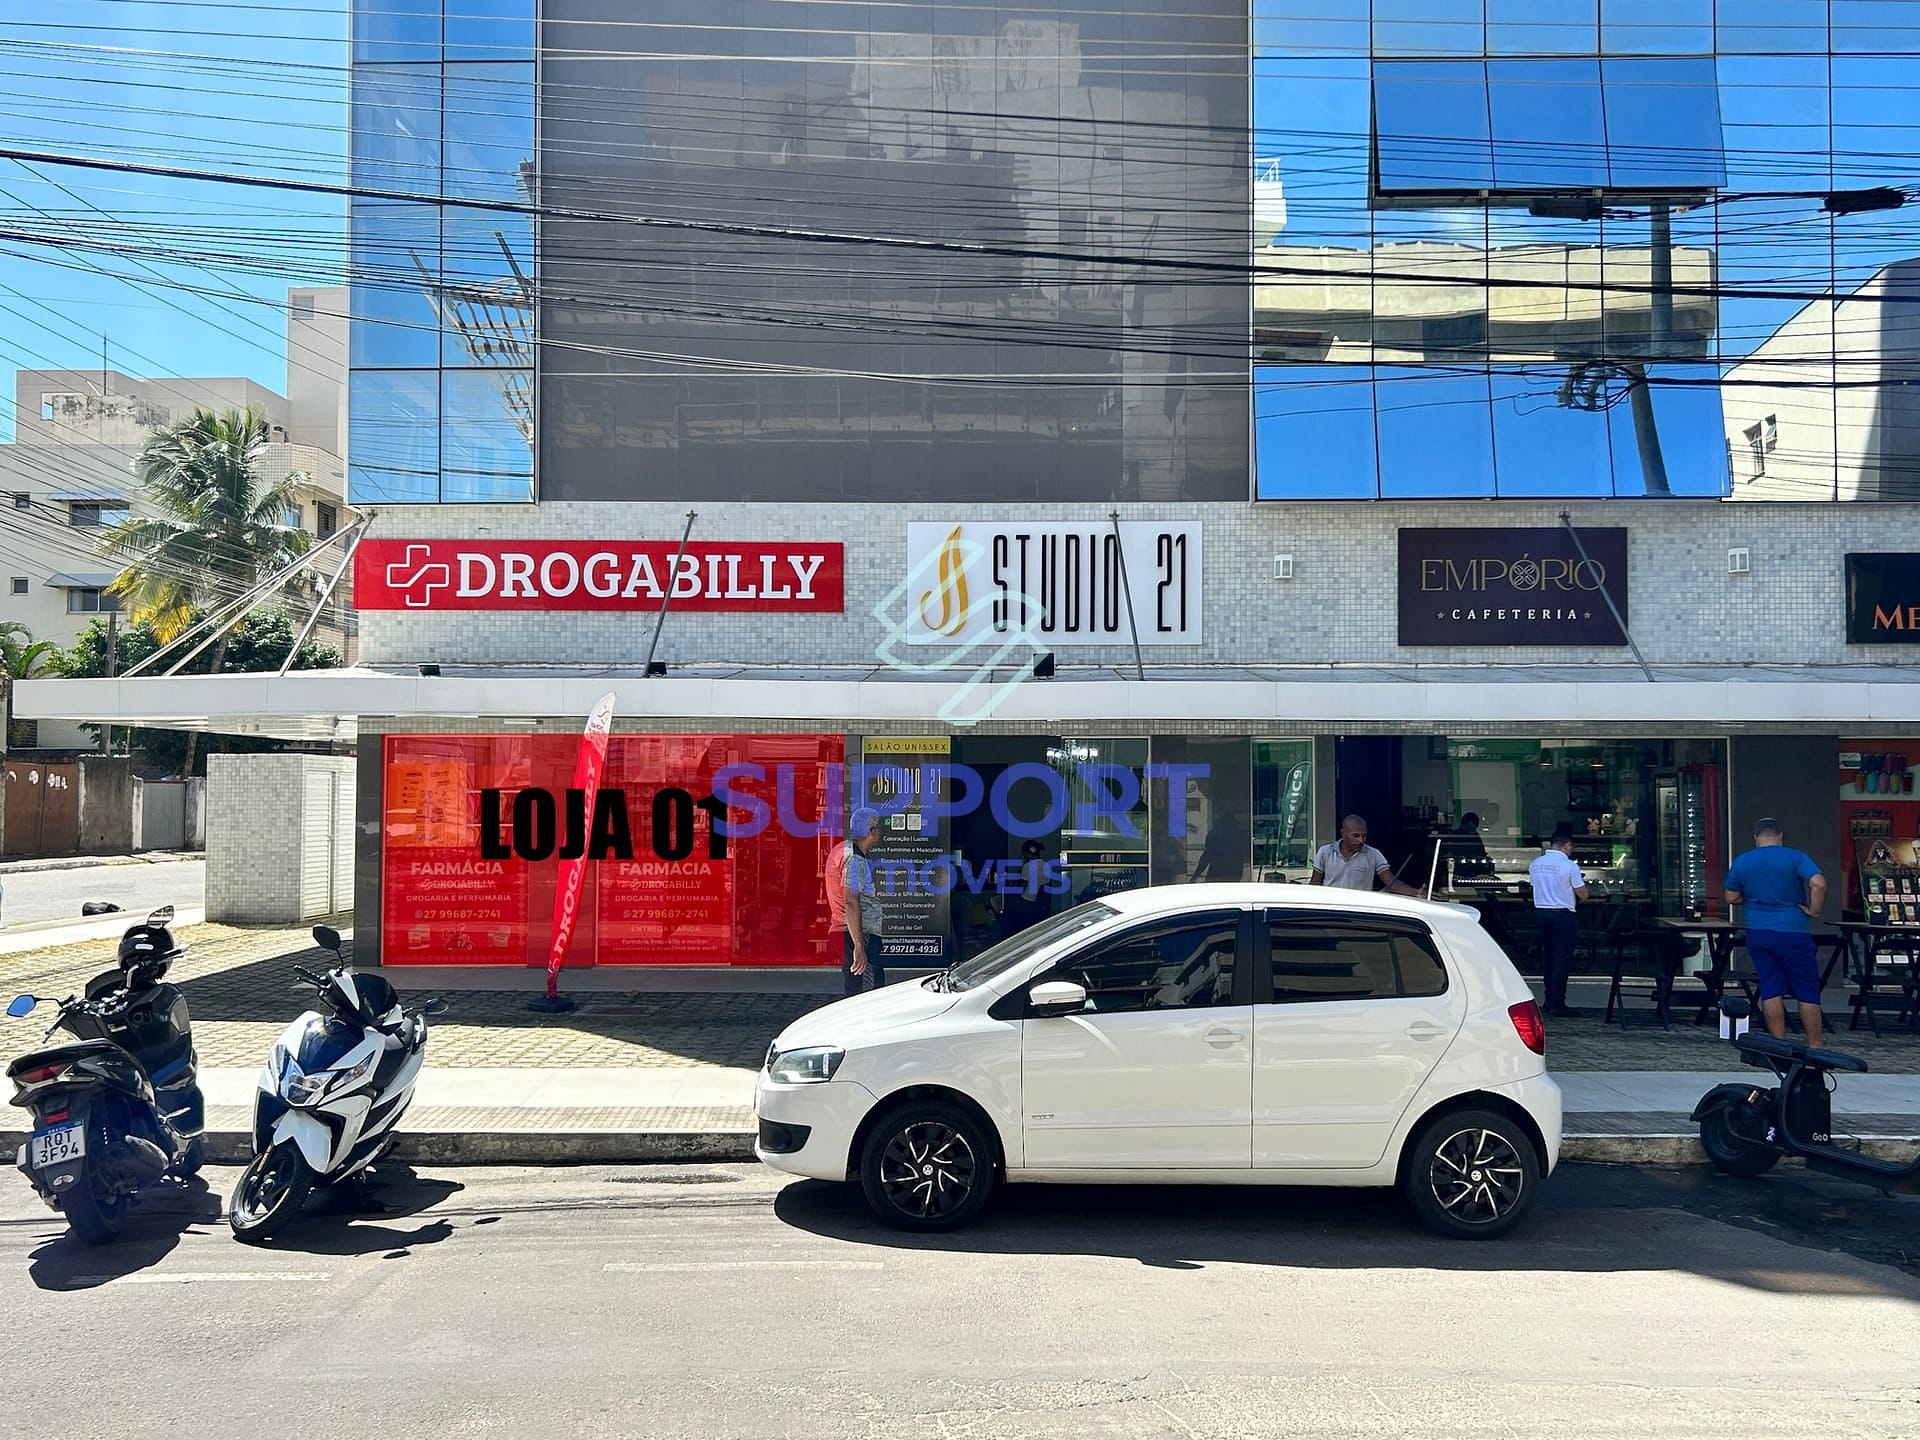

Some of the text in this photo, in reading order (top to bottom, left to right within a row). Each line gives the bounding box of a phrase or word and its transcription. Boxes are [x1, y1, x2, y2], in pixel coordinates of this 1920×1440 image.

[456, 552, 825, 600] DROGABILLY
[1420, 553, 1606, 591] EMPÓRIO
[993, 533, 1186, 632] STUDIO 21
[1451, 609, 1577, 620] CAFETERIA
[904, 743, 947, 751] UNISSEX
[884, 768, 941, 794] STUDIO 21
[410, 859, 504, 875] FARMÁCIA
[641, 879, 702, 889] DROGABILLY
[459, 894, 512, 902] PERFUMARIA
[423, 909, 501, 919] 27 99687-2741
[631, 909, 709, 919] 27 99687-2741
[889, 945, 939, 953] 99718-4936
[44, 1129, 73, 1149] RQT
[40, 1142, 80, 1163] 3F94
